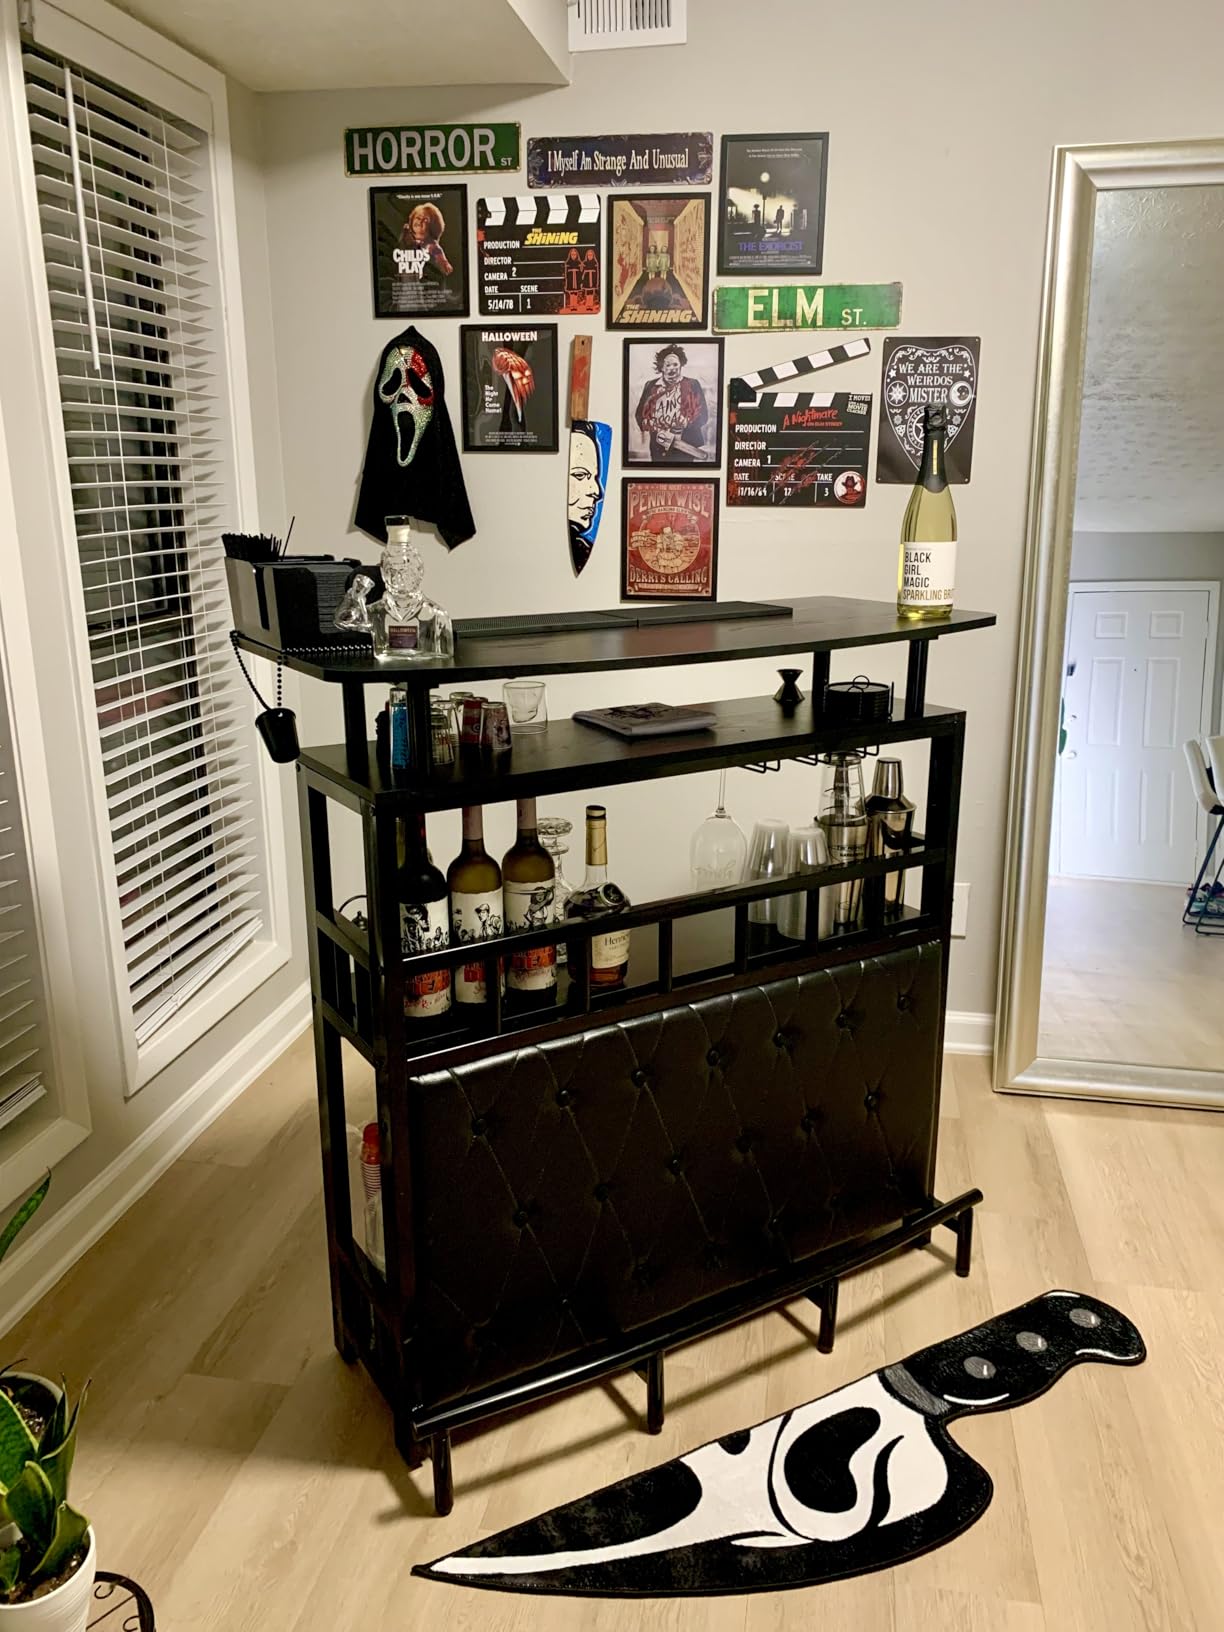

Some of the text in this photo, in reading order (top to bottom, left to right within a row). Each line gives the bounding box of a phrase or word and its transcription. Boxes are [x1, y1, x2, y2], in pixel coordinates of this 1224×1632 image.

[352, 128, 513, 170] HORROR ST
[547, 148, 689, 176] I Myself Am Strange And Unusual
[483, 240, 520, 249] PRODUCTION
[484, 256, 512, 265] DIRECTOR
[398, 261, 426, 280] PLAY
[484, 267, 517, 281] CAMERA 2
[520, 285, 538, 293] SCENE
[526, 298, 531, 309] 1
[747, 287, 867, 327] ELM ST.
[481, 331, 538, 342] HALLOWEEN
[898, 362, 963, 374] WE ARE THE
[907, 374, 954, 386] WEIRDOS
[908, 387, 948, 403] MISTER
[782, 414, 790, 430] A
[791, 408, 838, 425] Nightmare
[735, 424, 777, 433] PRODUCTION
[734, 442, 767, 450] DIRECTOR
[734, 455, 771, 467] CAMERA 1
[817, 473, 833, 481] TAKE
[824, 488, 829, 497] 3
[904, 552, 932, 563] BLACK
[667, 567, 708, 583] CALLING
[904, 564, 921, 575] GIRL
[903, 577, 930, 588] MAGIC
[902, 589, 942, 600] SPARKLING
